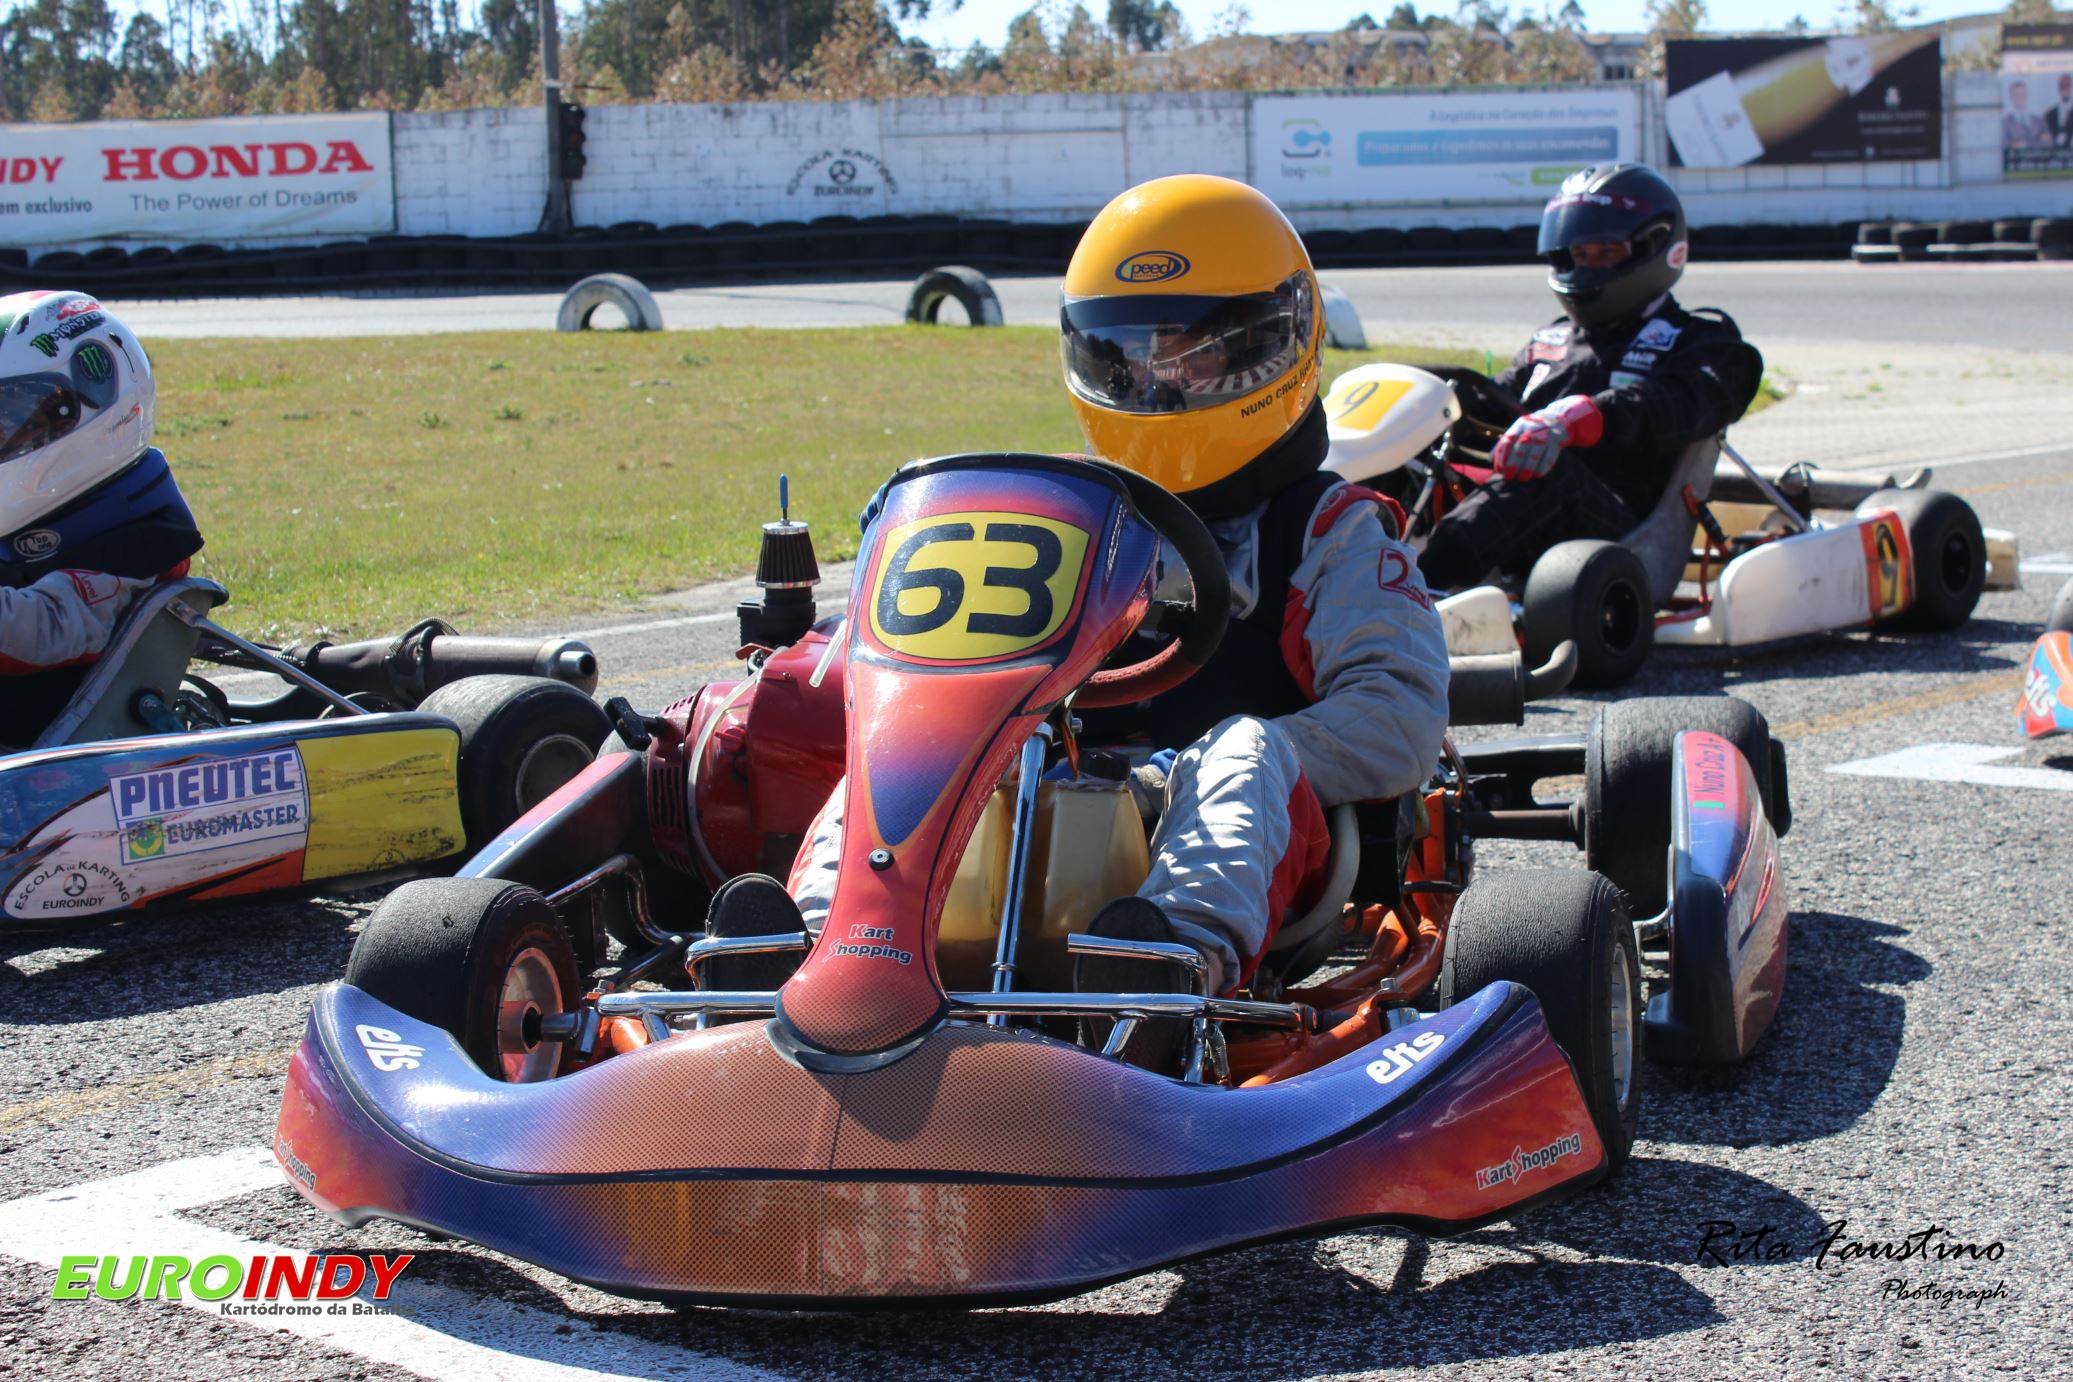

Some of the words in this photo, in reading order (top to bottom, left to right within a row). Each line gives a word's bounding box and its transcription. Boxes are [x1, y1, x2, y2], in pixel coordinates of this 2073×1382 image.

[101, 140, 374, 182] HONDA
[25, 196, 93, 213] exclusivo
[130, 194, 170, 212] The
[177, 192, 242, 211] Power
[249, 191, 267, 208] of
[275, 189, 358, 207] Dreams
[1240, 395, 1273, 418] NUNO
[1276, 375, 1298, 399] CRUZ
[1334, 381, 1380, 420] 9
[876, 522, 1063, 638] 63
[1876, 523, 1898, 609] 9
[166, 804, 300, 845] EUROMASTER
[14, 864, 65, 910] ESCOLA
[78, 860, 131, 903] KARTING
[42, 895, 105, 910] EUROINDY
[822, 937, 913, 965] Shopping
[848, 923, 895, 941] Kart
